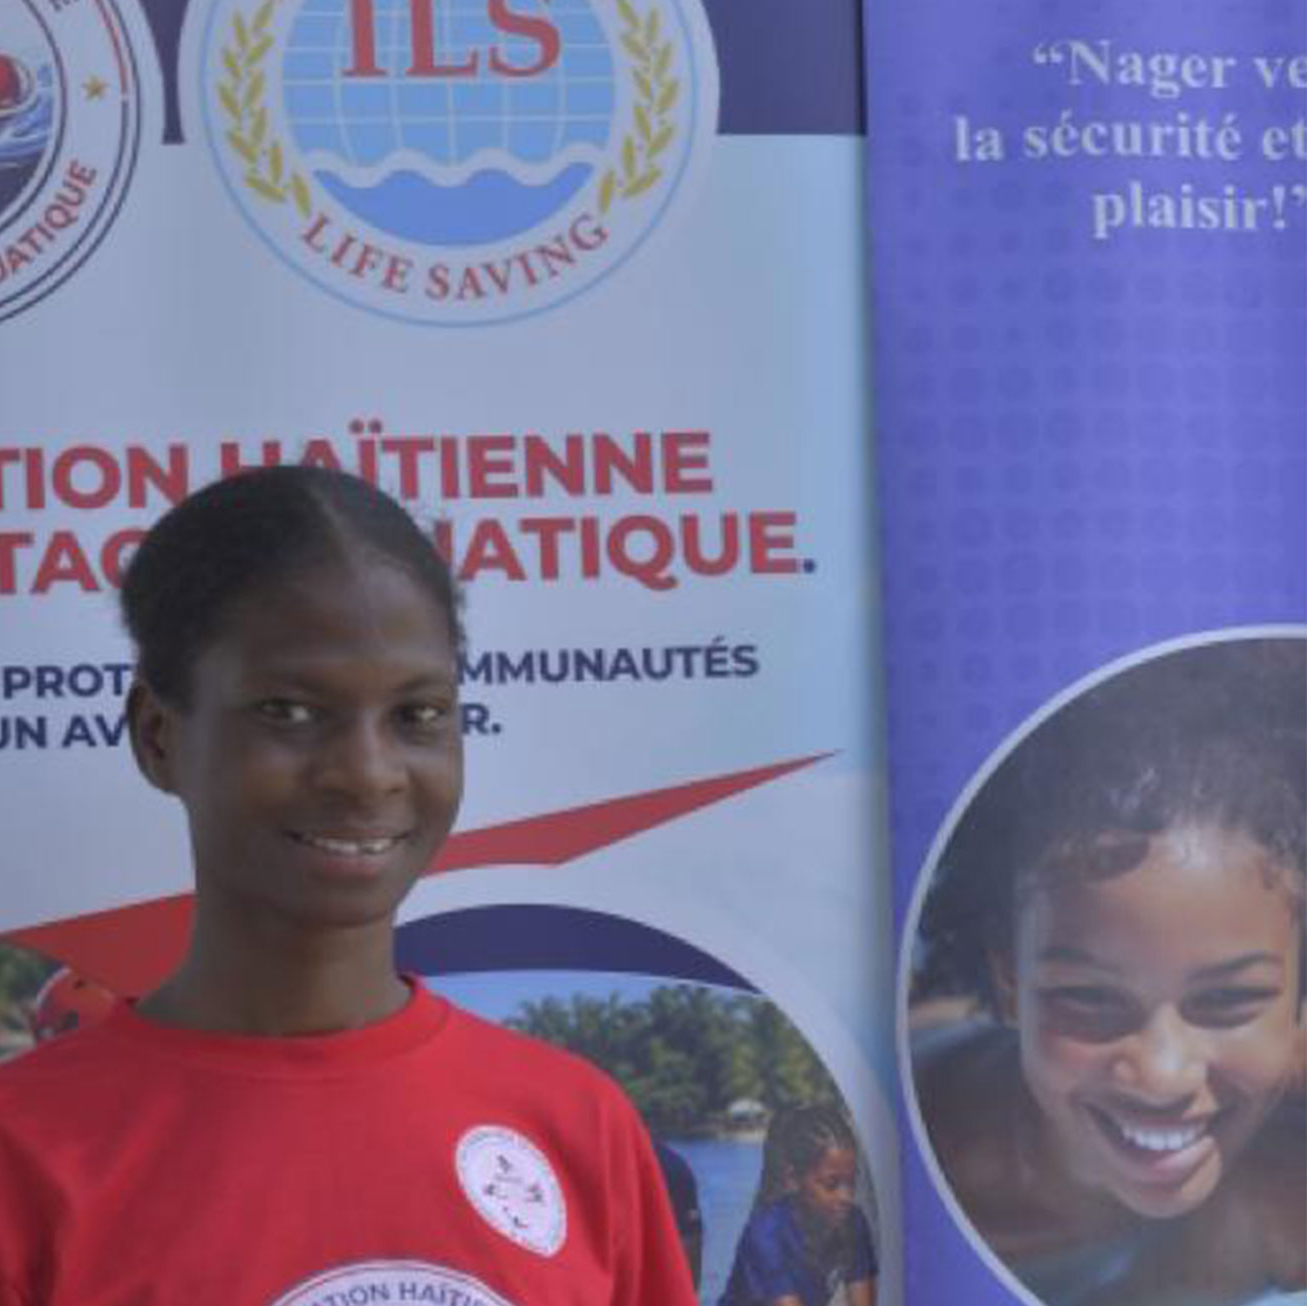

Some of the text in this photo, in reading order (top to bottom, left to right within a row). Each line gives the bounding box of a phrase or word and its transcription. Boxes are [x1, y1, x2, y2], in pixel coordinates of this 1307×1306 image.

[1253, 54, 1307, 88] ve
[954, 115, 1004, 161] la
[1023, 109, 1242, 161] sécurité
[301, 210, 610, 301] LIFE SAVING
[2, 663, 130, 701] PROT
[457, 636, 759, 686] MMUNAUTÉS
